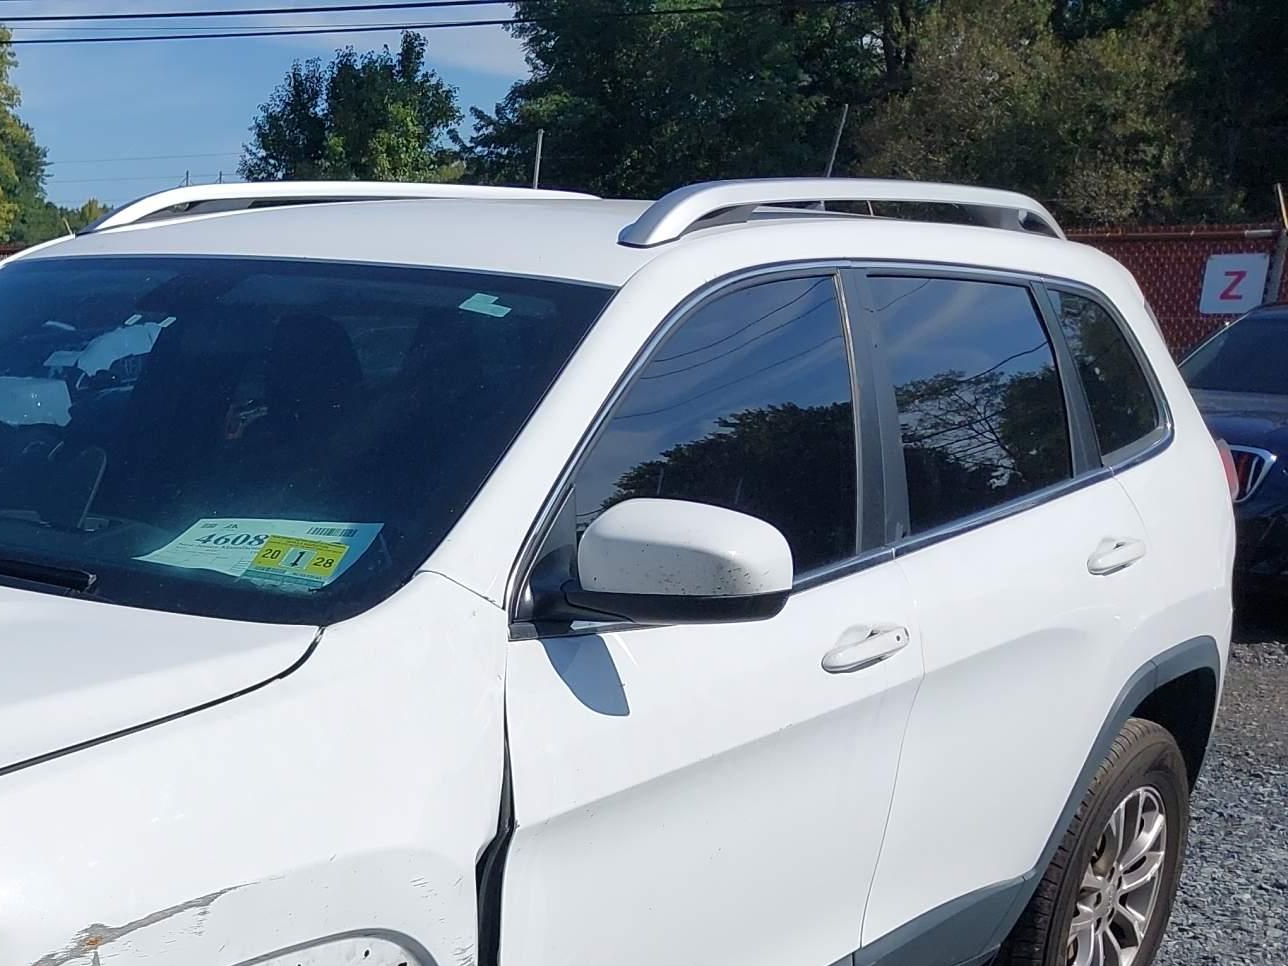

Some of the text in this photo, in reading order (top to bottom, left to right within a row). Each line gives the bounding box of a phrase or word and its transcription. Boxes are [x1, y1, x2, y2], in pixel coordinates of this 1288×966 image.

[1220, 271, 1248, 300] Z
[195, 533, 269, 546] 4608
[262, 548, 281, 560] 20
[313, 556, 335, 568] 28
